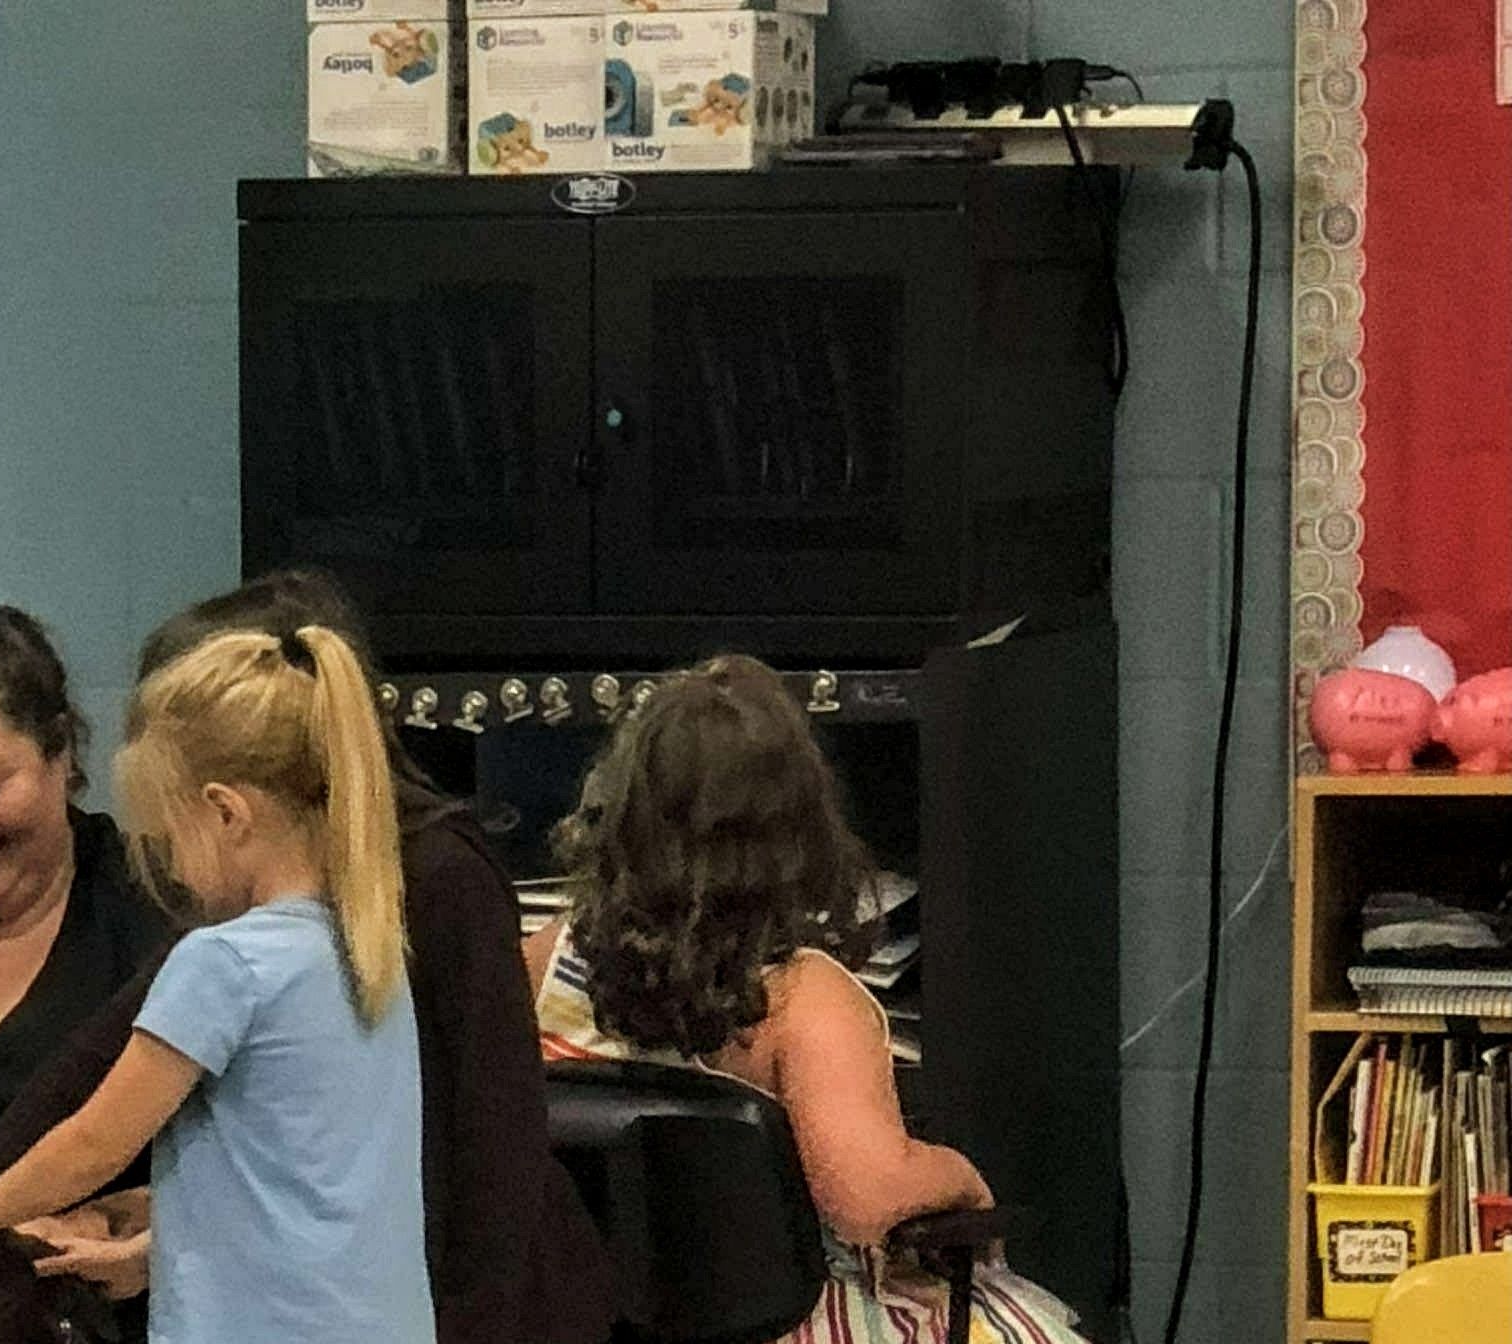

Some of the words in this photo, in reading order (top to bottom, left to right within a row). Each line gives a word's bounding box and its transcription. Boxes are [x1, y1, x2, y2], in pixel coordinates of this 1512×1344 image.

[322, 55, 373, 74] botley
[544, 122, 596, 139] botley
[612, 143, 666, 159] botley
